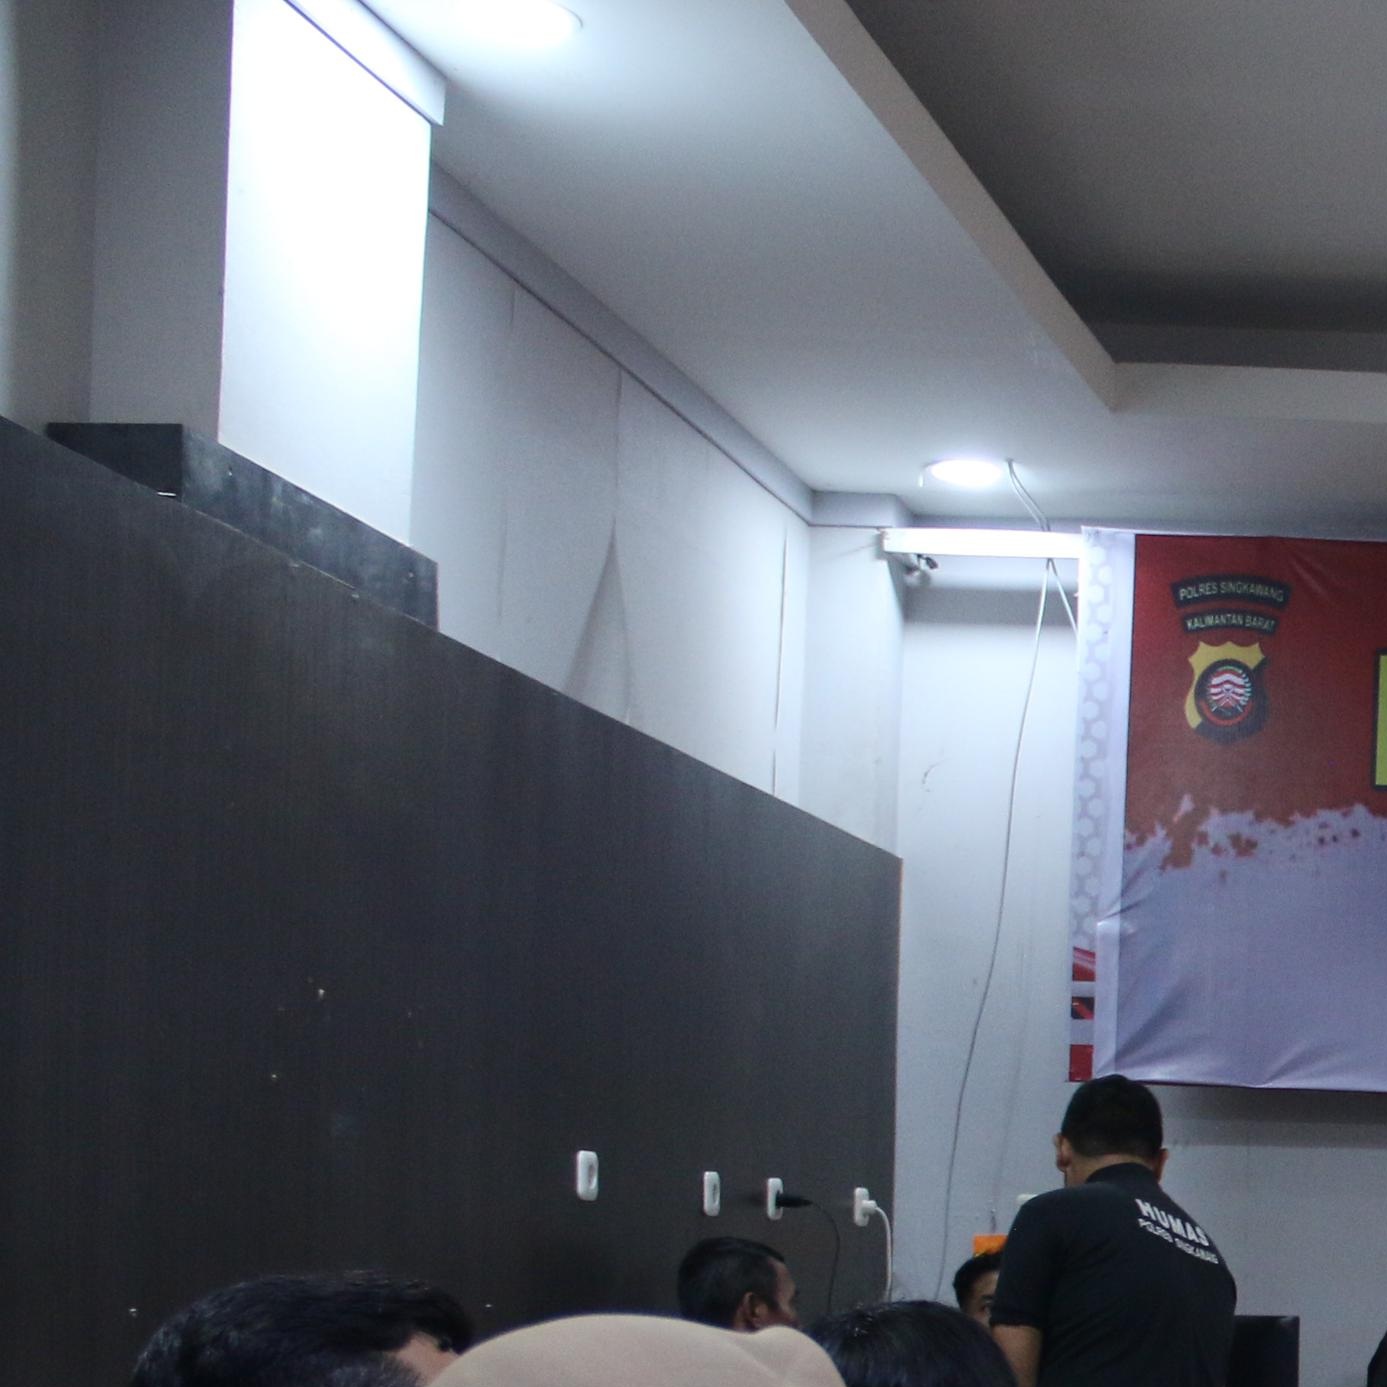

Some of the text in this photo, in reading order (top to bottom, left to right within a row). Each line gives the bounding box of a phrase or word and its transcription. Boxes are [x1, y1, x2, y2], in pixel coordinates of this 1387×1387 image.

[1179, 581, 1284, 602] POLRES SINGKAWANG
[1186, 613, 1276, 632] KALIMANTAN BARAT
[1135, 1198, 1209, 1246] HUMAS
